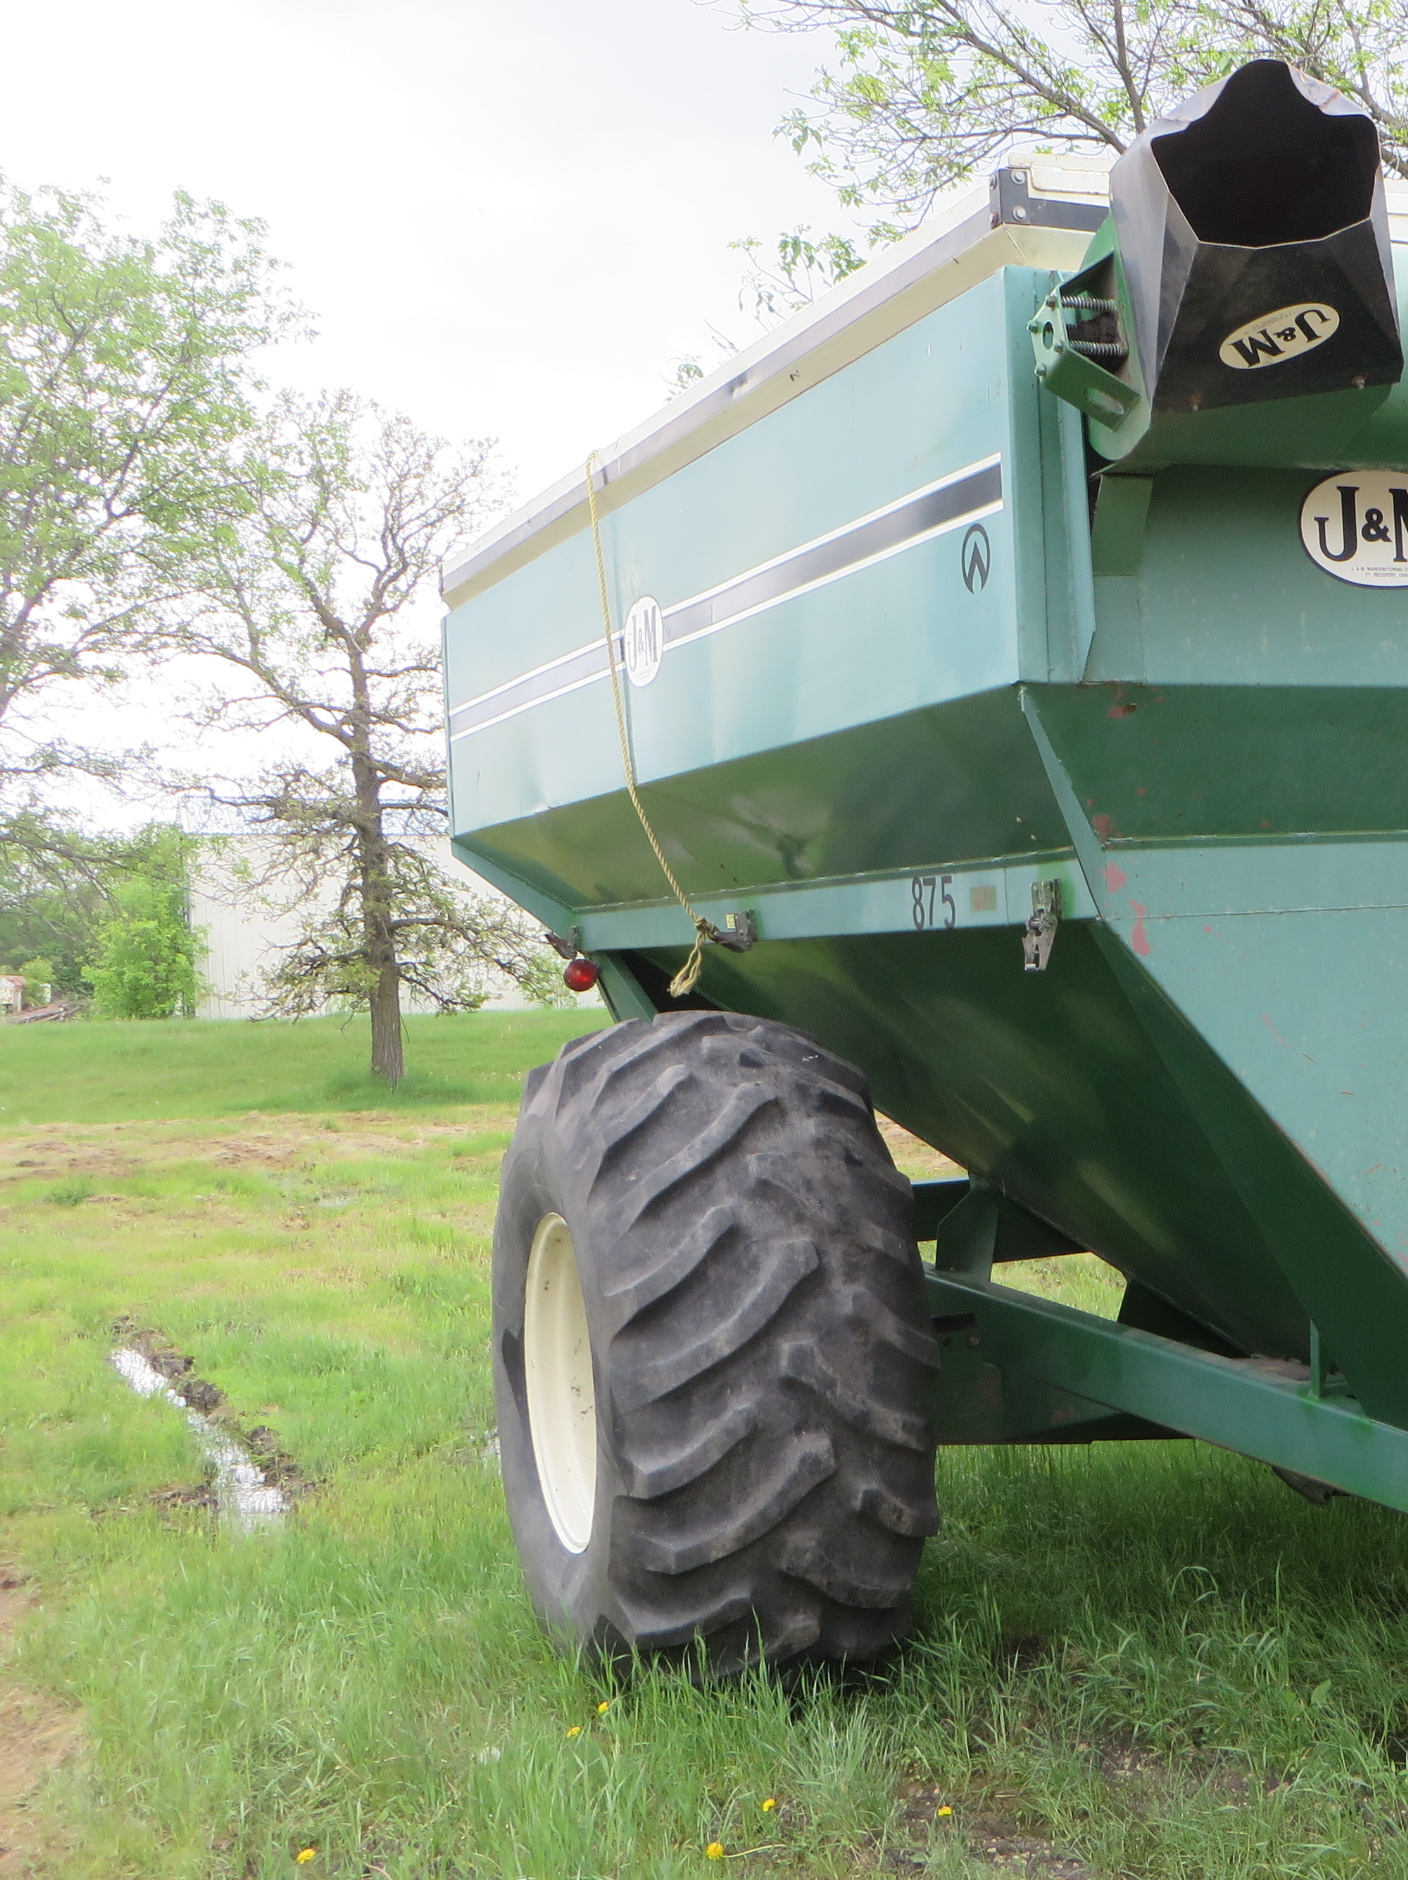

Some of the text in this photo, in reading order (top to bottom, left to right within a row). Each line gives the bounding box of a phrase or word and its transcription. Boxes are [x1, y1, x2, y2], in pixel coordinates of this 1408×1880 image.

[1230, 309, 1332, 368] J&M
[627, 605, 659, 673] J&M
[911, 876, 957, 931] 875
